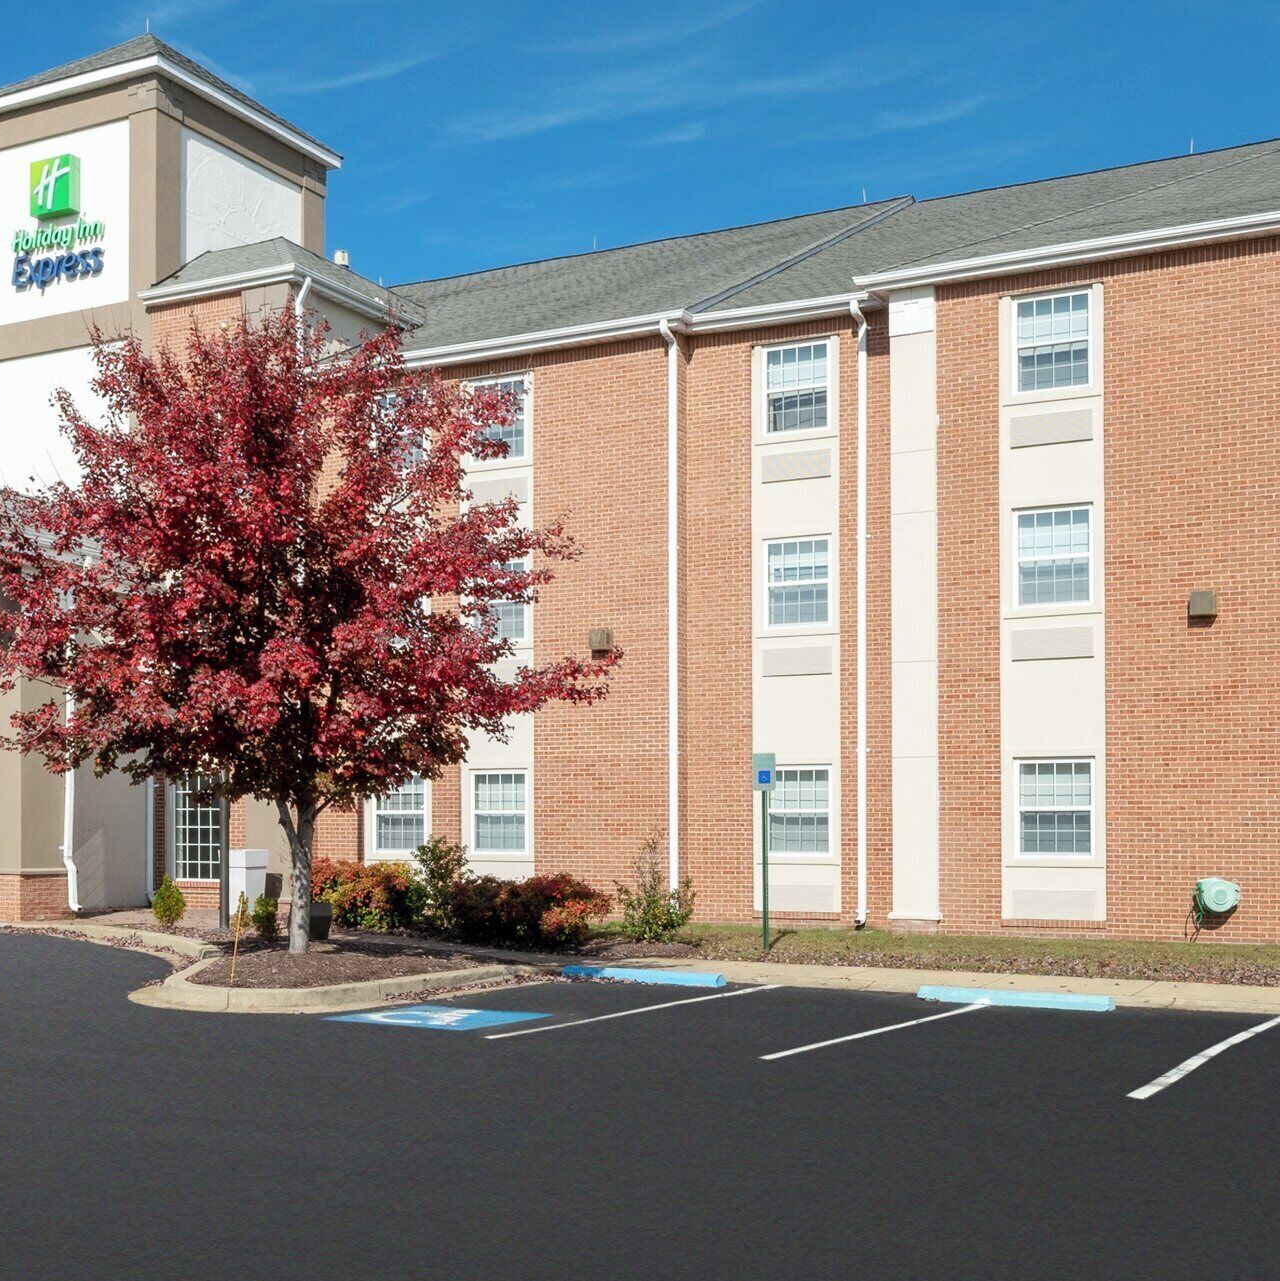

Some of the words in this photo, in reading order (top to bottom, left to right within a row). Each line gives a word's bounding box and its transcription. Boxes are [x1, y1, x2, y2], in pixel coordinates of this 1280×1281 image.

[33, 158, 70, 209] H
[12, 223, 75, 253] Holiday
[77, 218, 103, 239] Inn
[12, 247, 104, 289] Express
